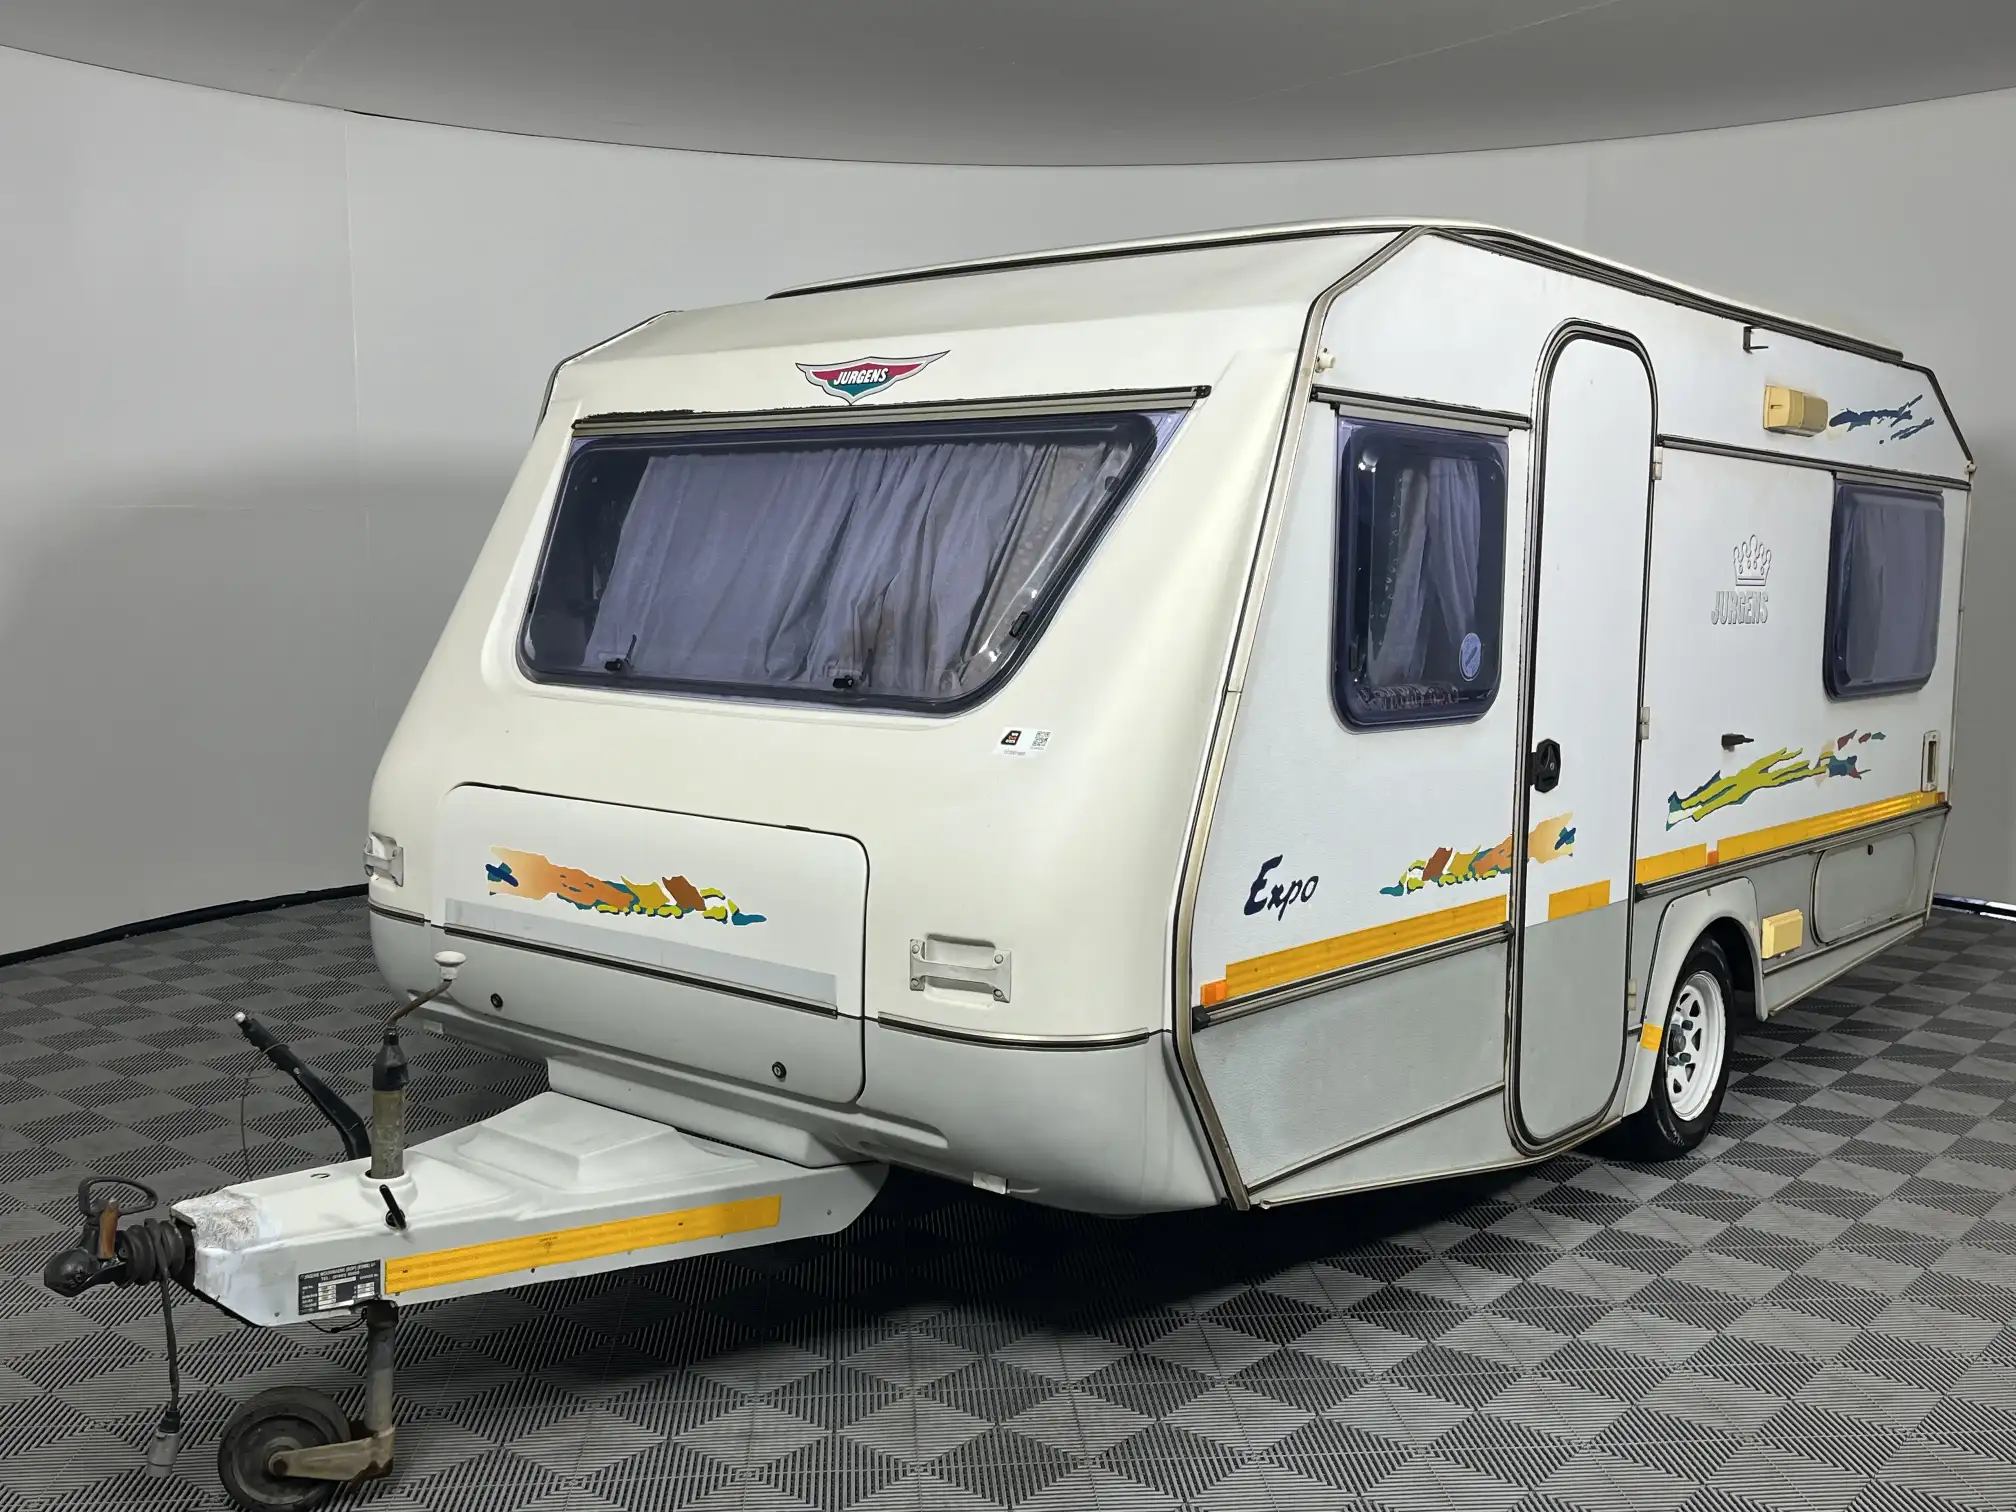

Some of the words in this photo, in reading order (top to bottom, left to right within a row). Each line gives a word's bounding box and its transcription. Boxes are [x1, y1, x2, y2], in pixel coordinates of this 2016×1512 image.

[834, 368, 889, 386] JURGENS
[1711, 591, 1769, 625] JURGENS
[1243, 853, 1319, 922] Expo
